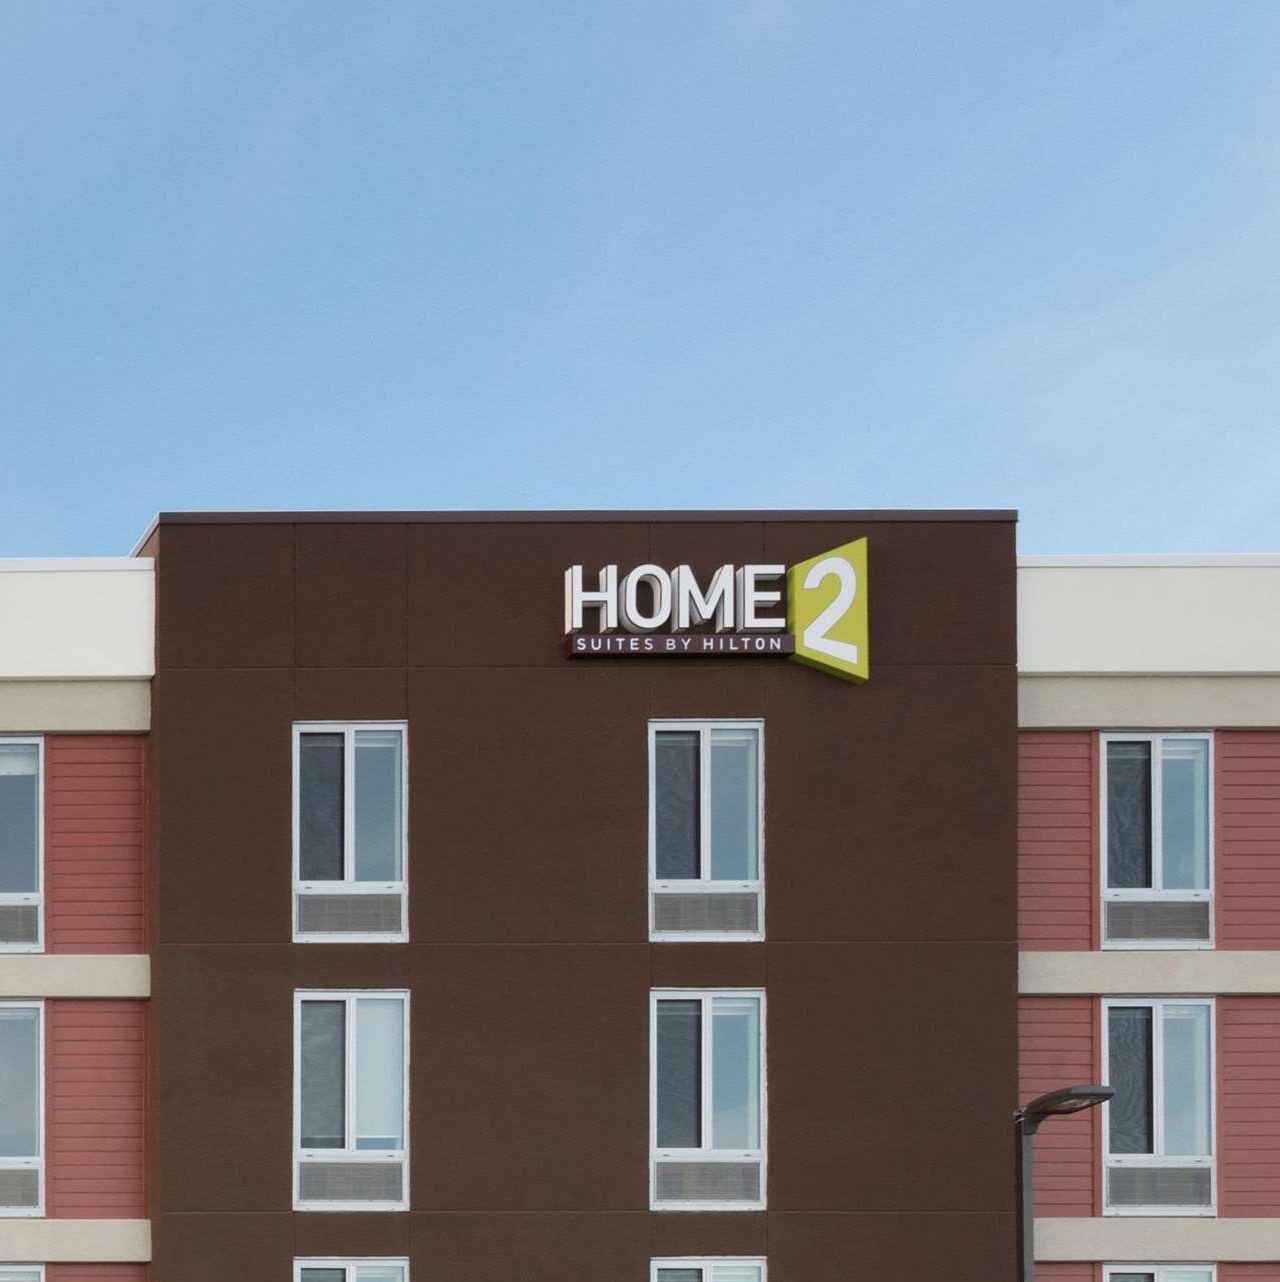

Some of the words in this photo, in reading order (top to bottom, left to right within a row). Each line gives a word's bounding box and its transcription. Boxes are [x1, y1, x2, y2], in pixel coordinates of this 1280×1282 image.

[576, 637, 654, 651] SUITES
[665, 637, 692, 651] BY
[702, 637, 782, 651] HILTON
